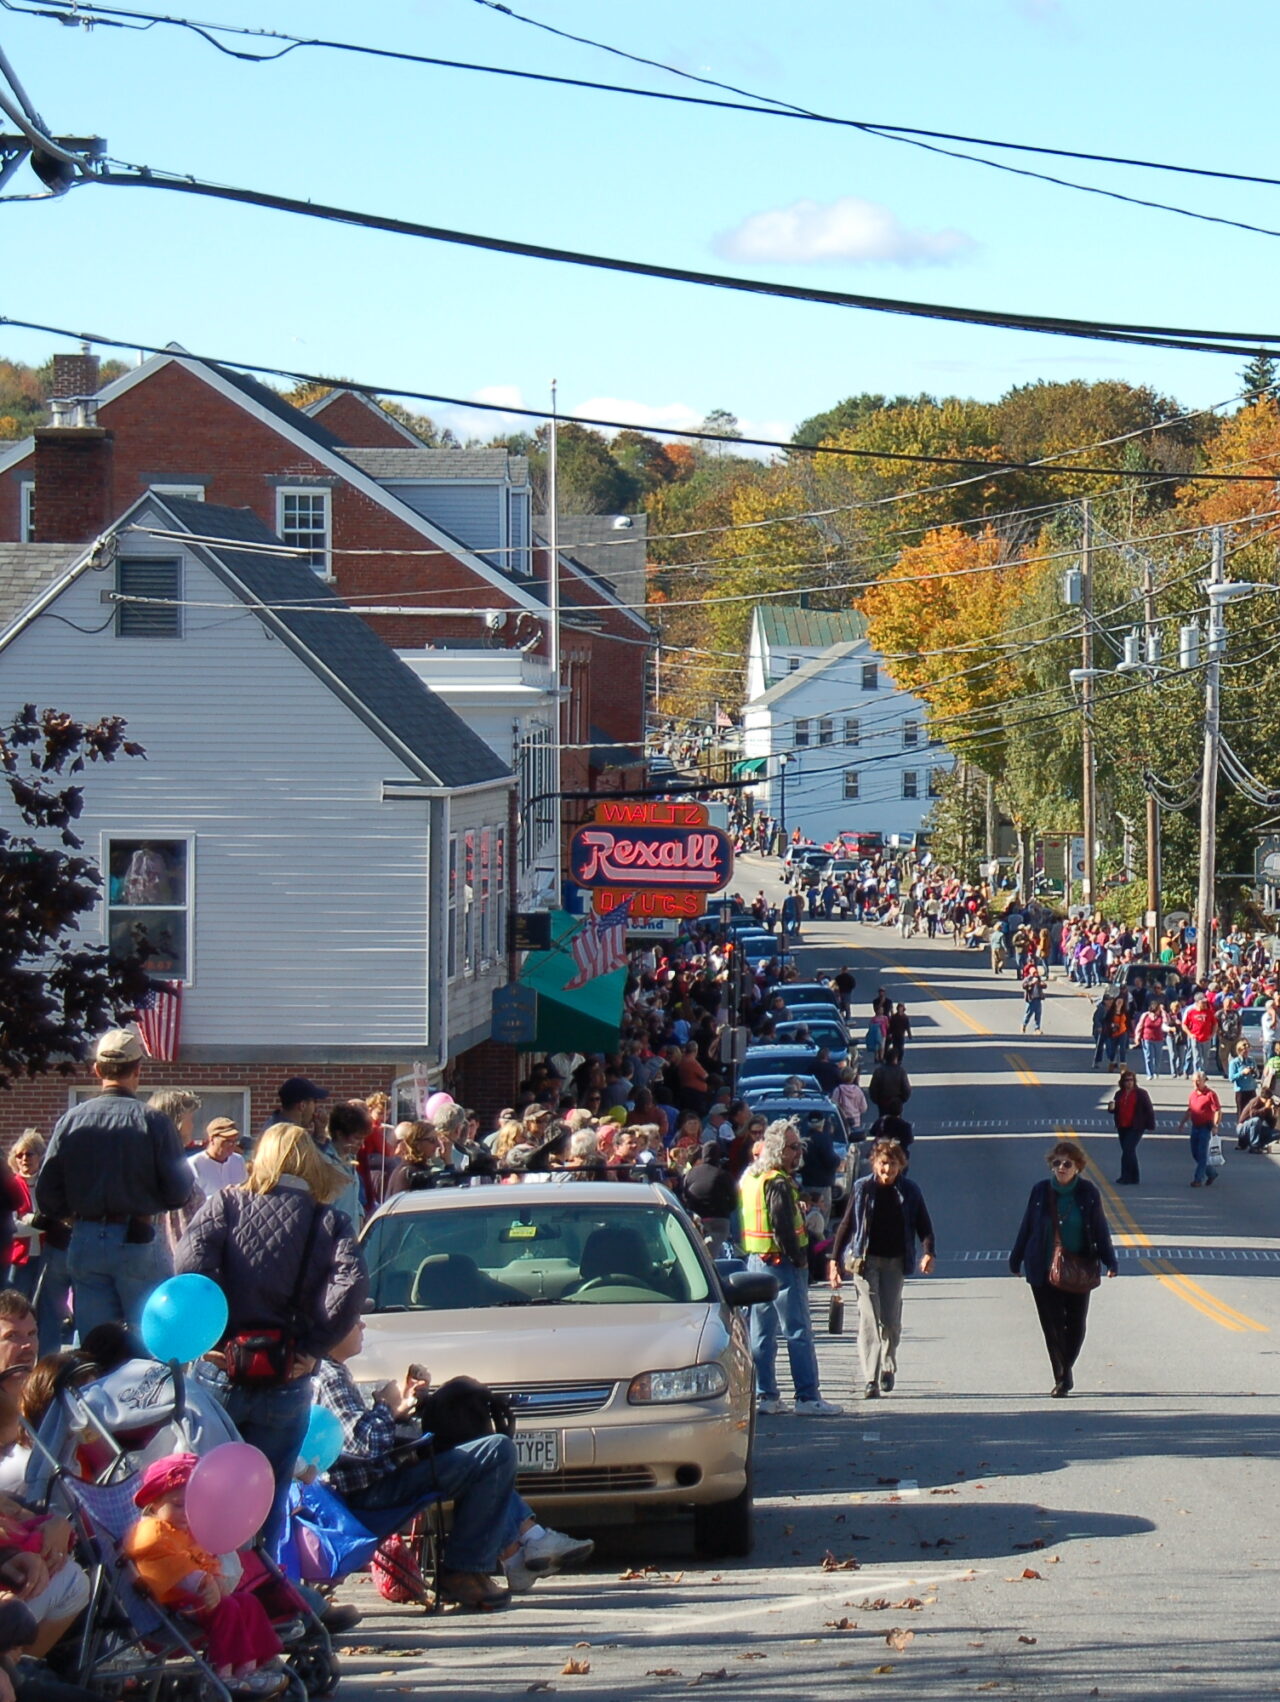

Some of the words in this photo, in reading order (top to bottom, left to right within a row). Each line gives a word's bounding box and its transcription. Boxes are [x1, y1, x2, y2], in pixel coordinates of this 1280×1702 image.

[603, 803, 703, 824] WALTZ
[581, 831, 721, 882] Rexall
[601, 892, 698, 914] DRUGS
